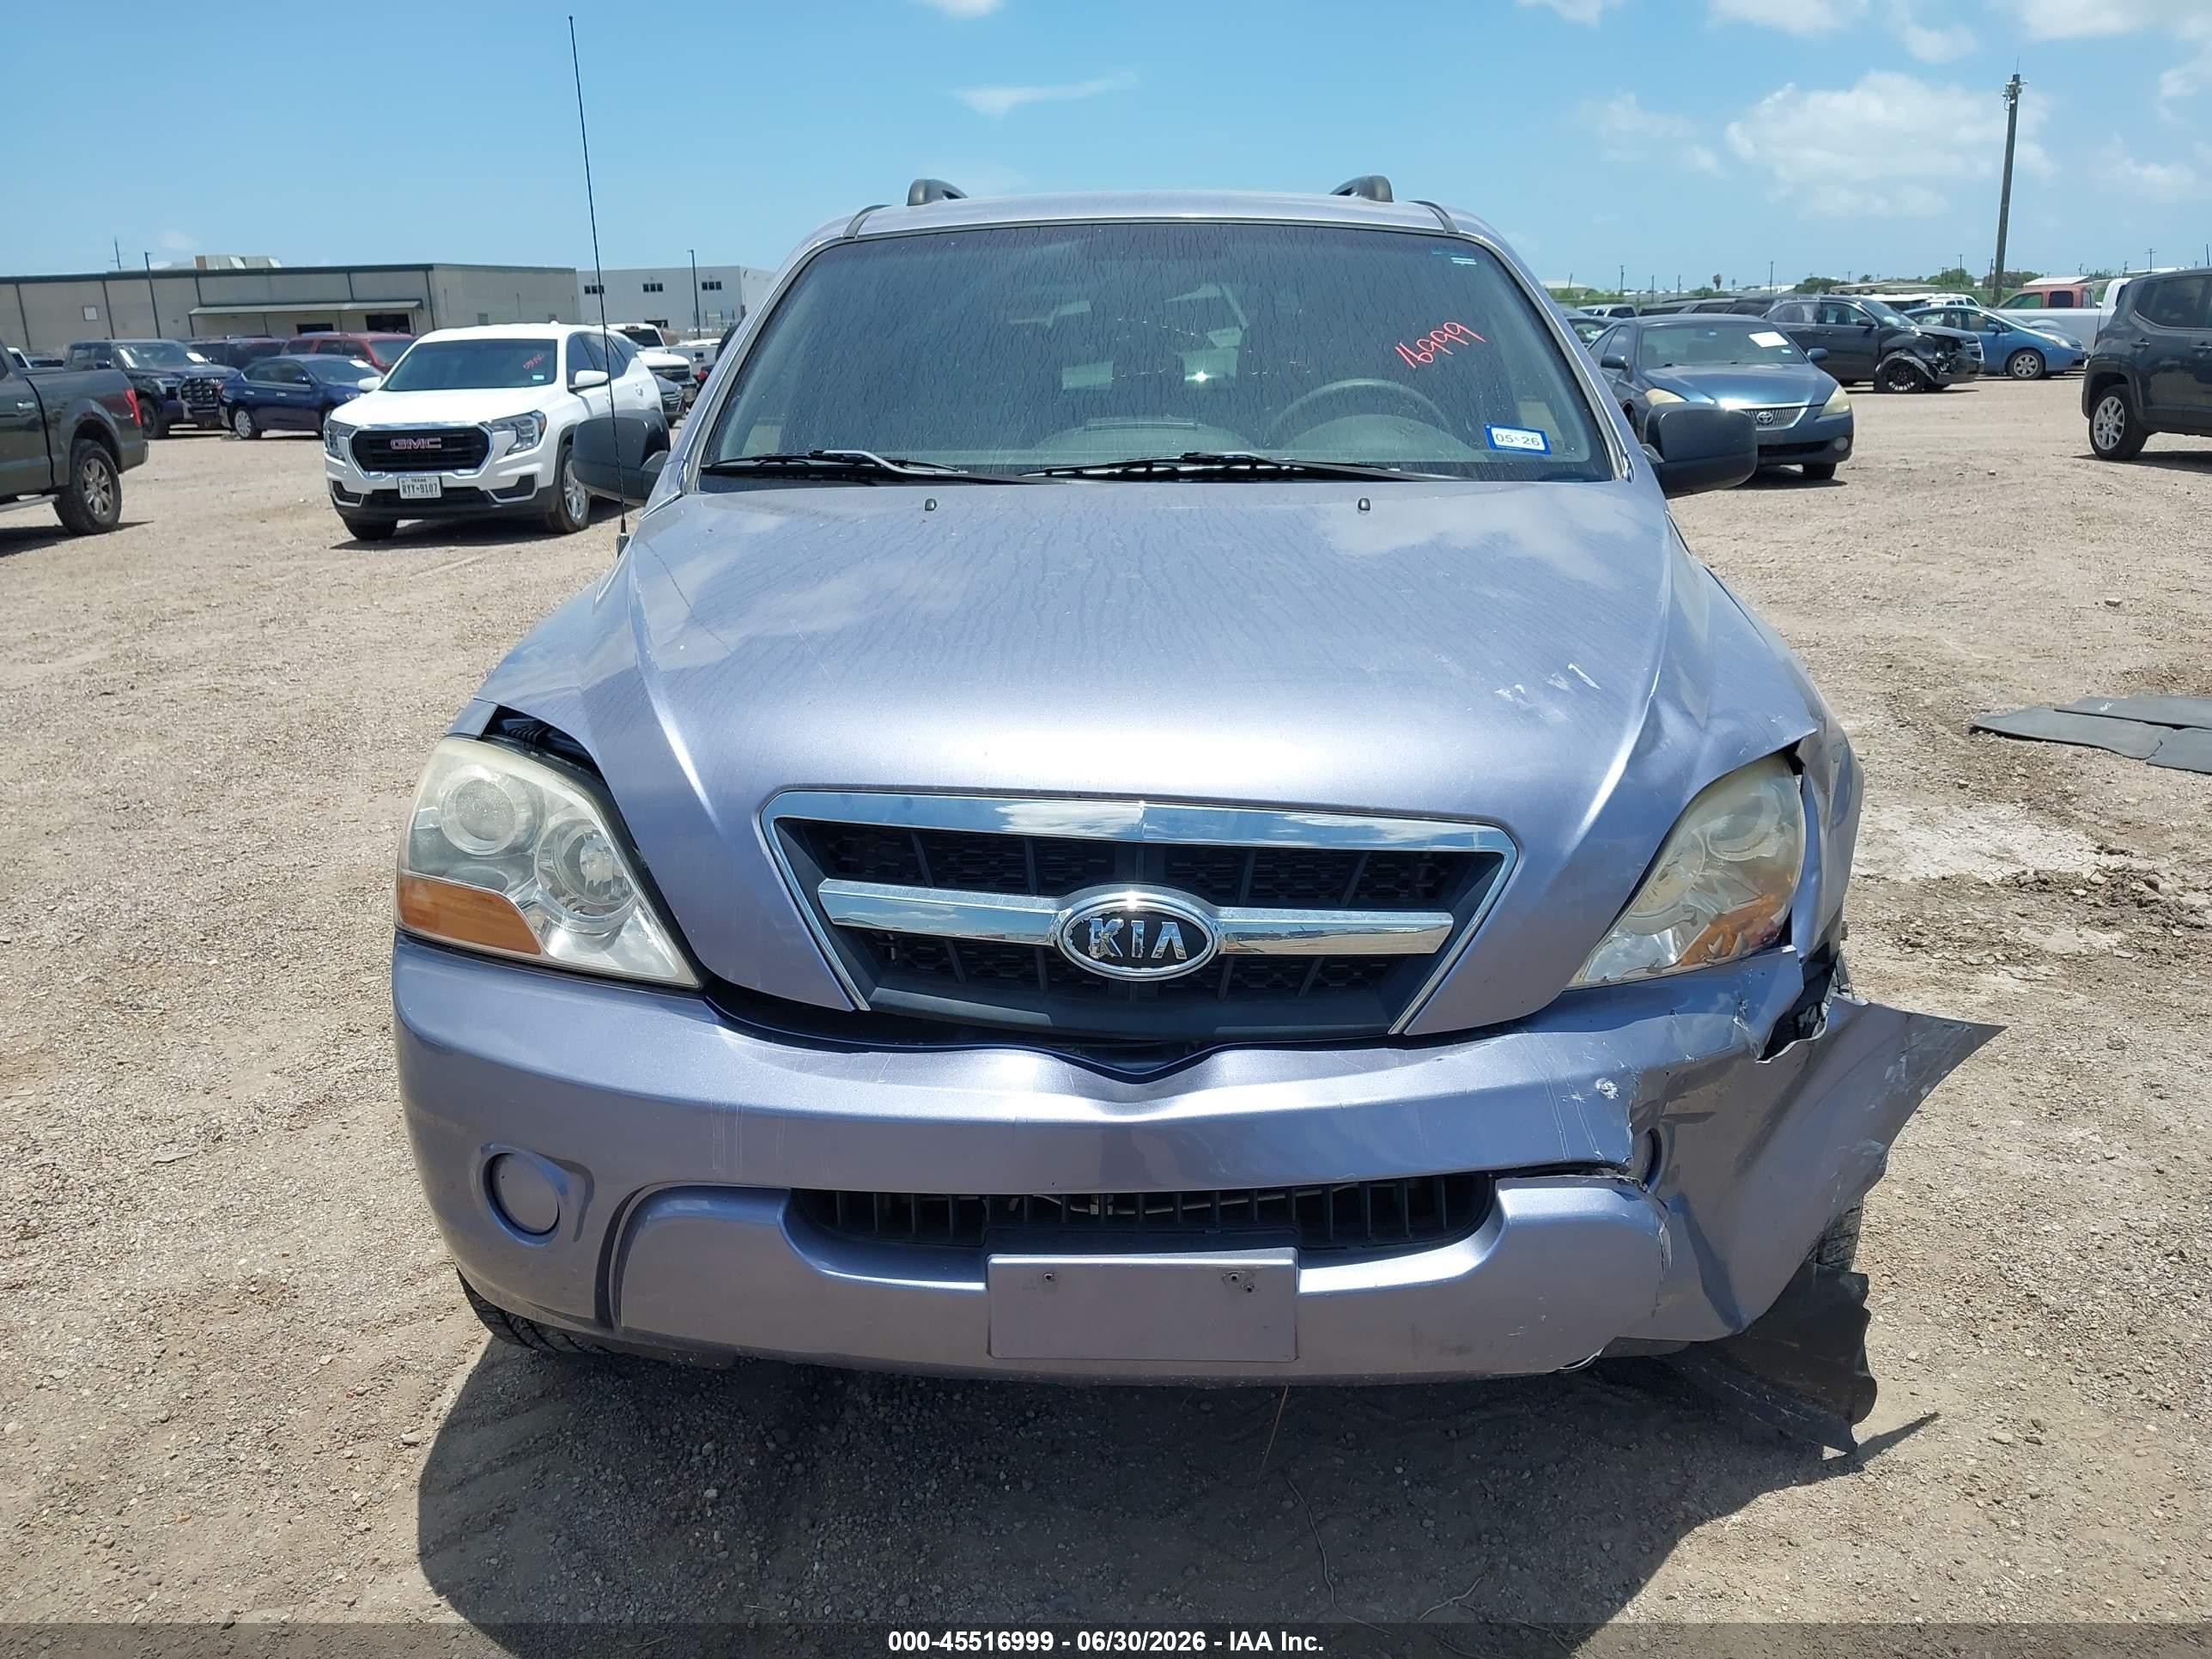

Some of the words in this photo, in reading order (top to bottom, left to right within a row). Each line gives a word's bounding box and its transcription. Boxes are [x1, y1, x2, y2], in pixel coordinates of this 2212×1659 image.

[1395, 322, 1486, 369] 16999
[390, 437, 442, 451] GMC
[1087, 917, 1188, 961] KIA
